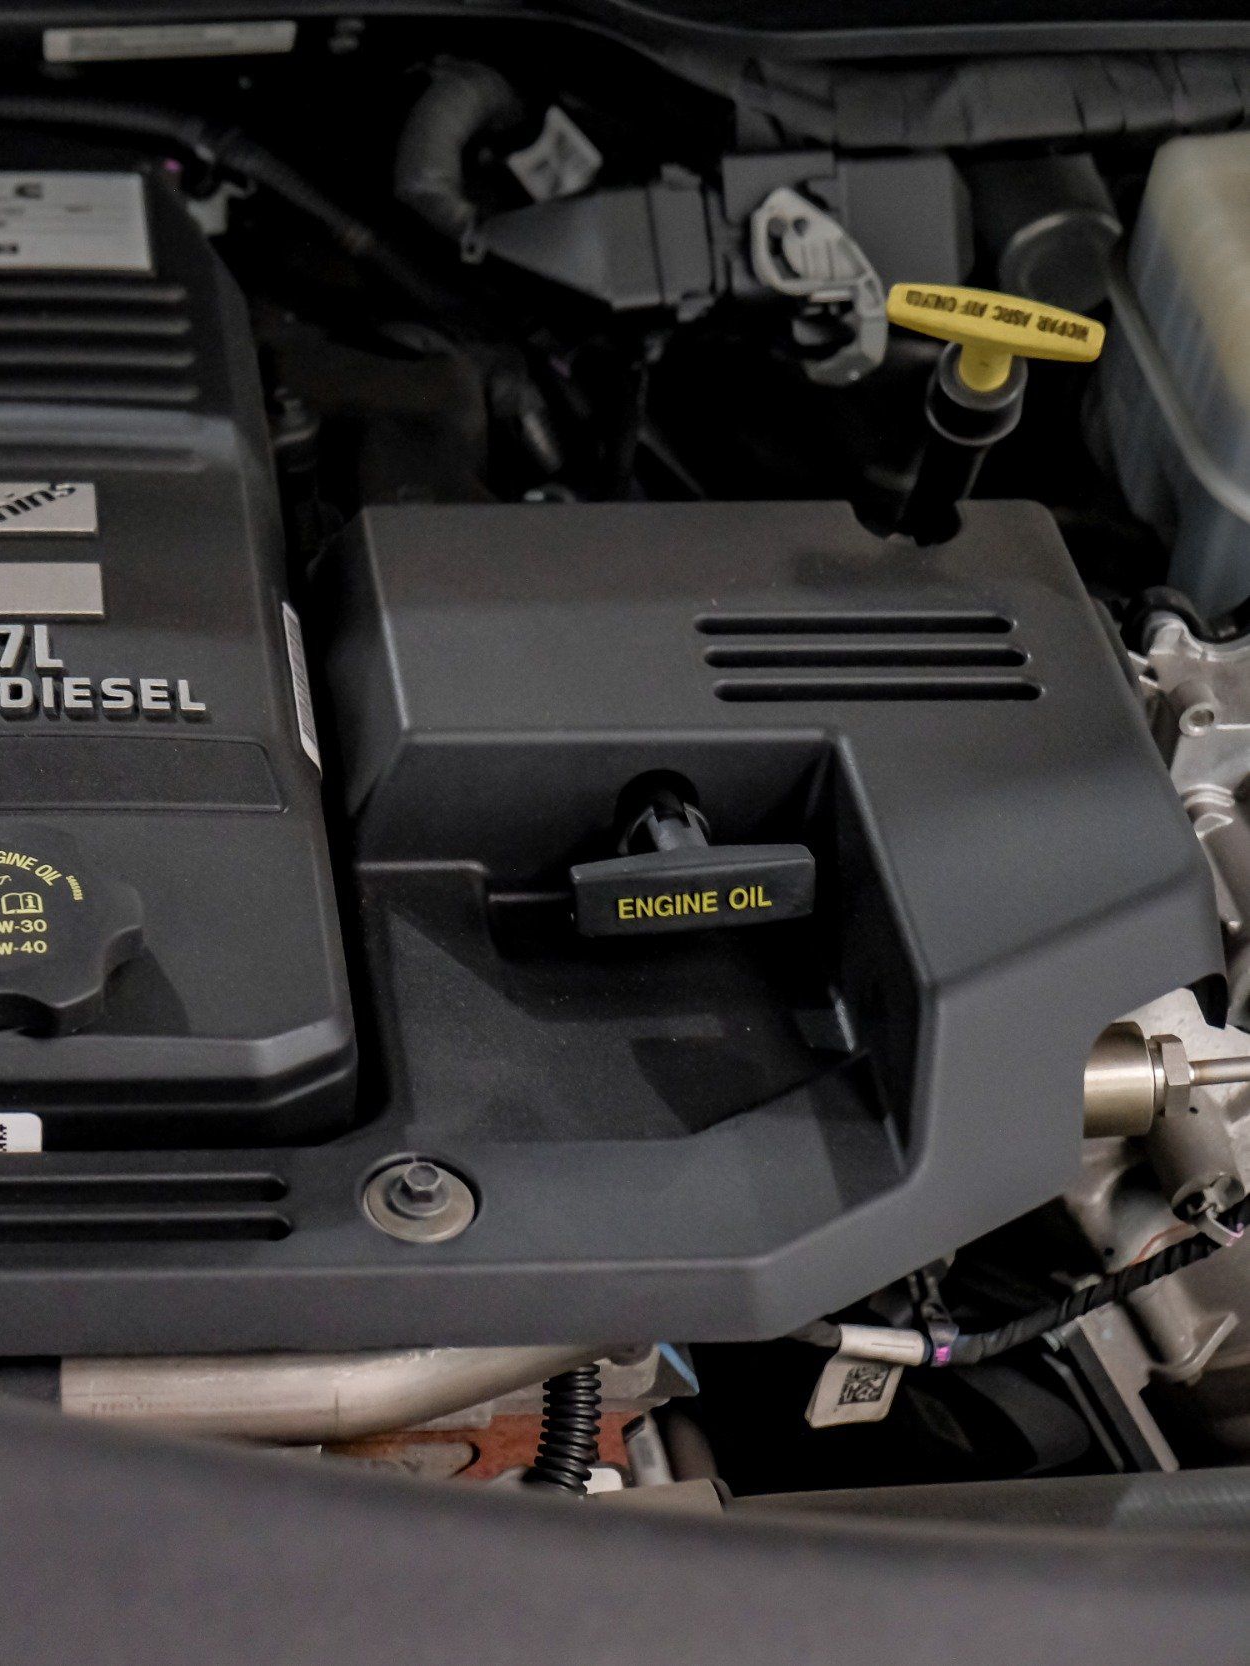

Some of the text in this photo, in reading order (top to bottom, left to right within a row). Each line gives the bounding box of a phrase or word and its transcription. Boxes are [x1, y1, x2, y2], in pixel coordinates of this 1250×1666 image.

[34, 864, 63, 886] OIL
[617, 885, 773, 920] ENGINE OIL
